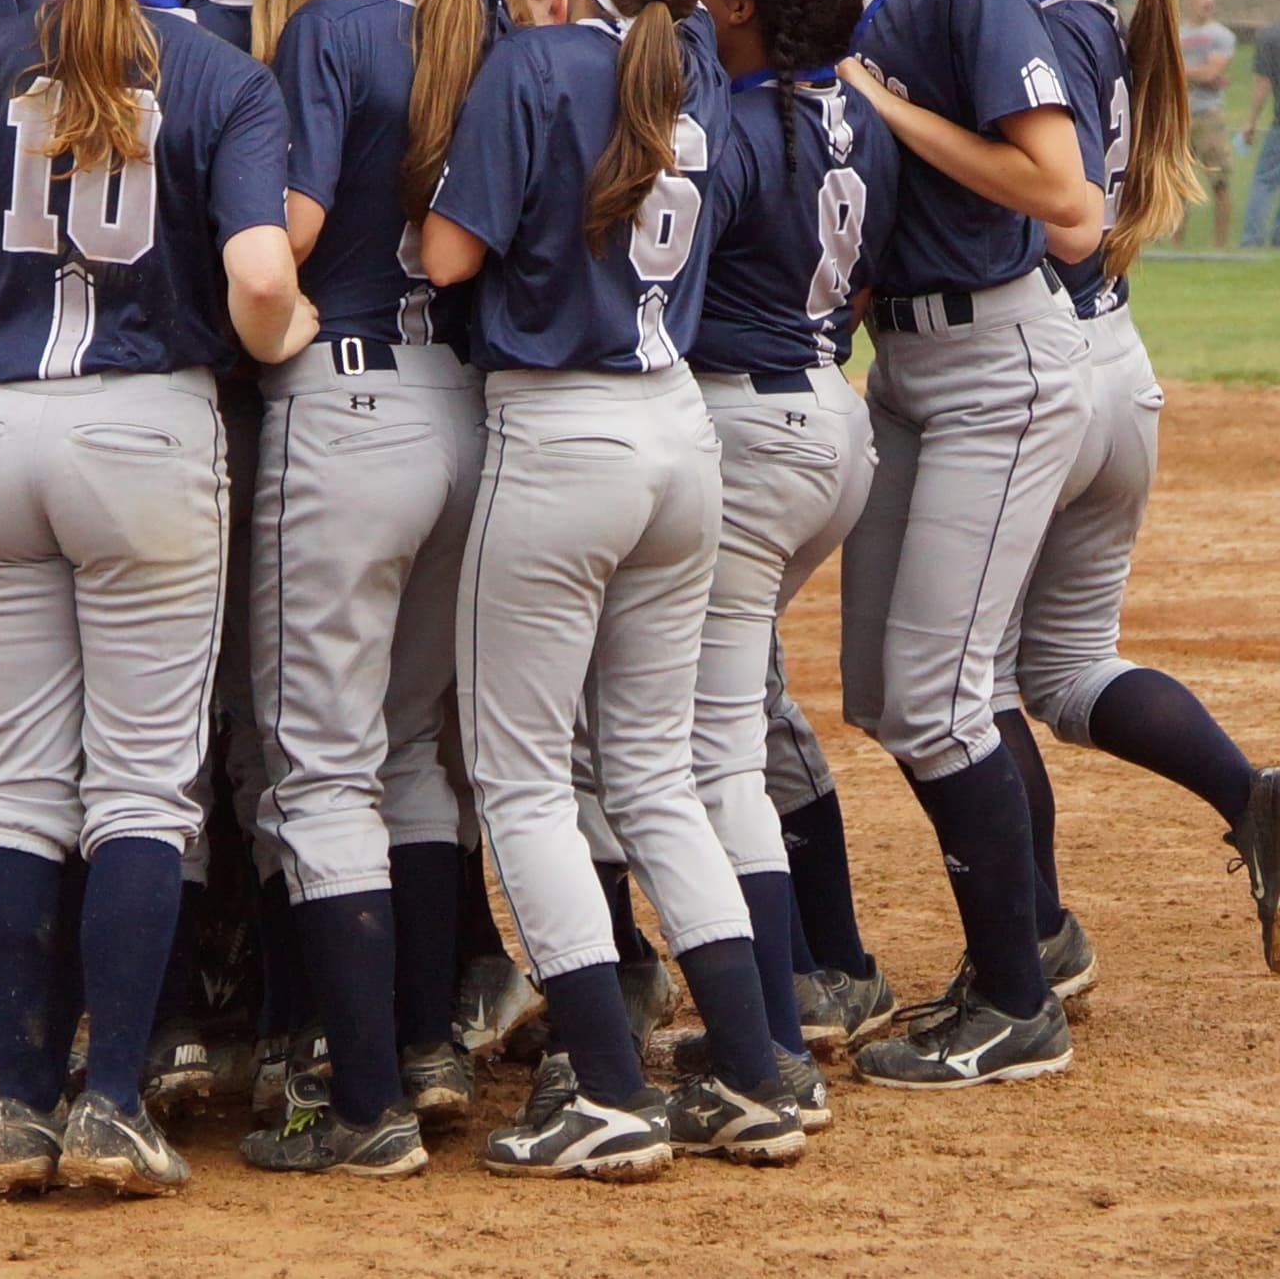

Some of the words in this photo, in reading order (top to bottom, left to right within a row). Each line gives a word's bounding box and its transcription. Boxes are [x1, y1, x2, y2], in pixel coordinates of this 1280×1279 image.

[3, 76, 163, 265] 10
[629, 113, 707, 281] 6
[806, 167, 867, 320] 8
[174, 1043, 208, 1067] NIKE
